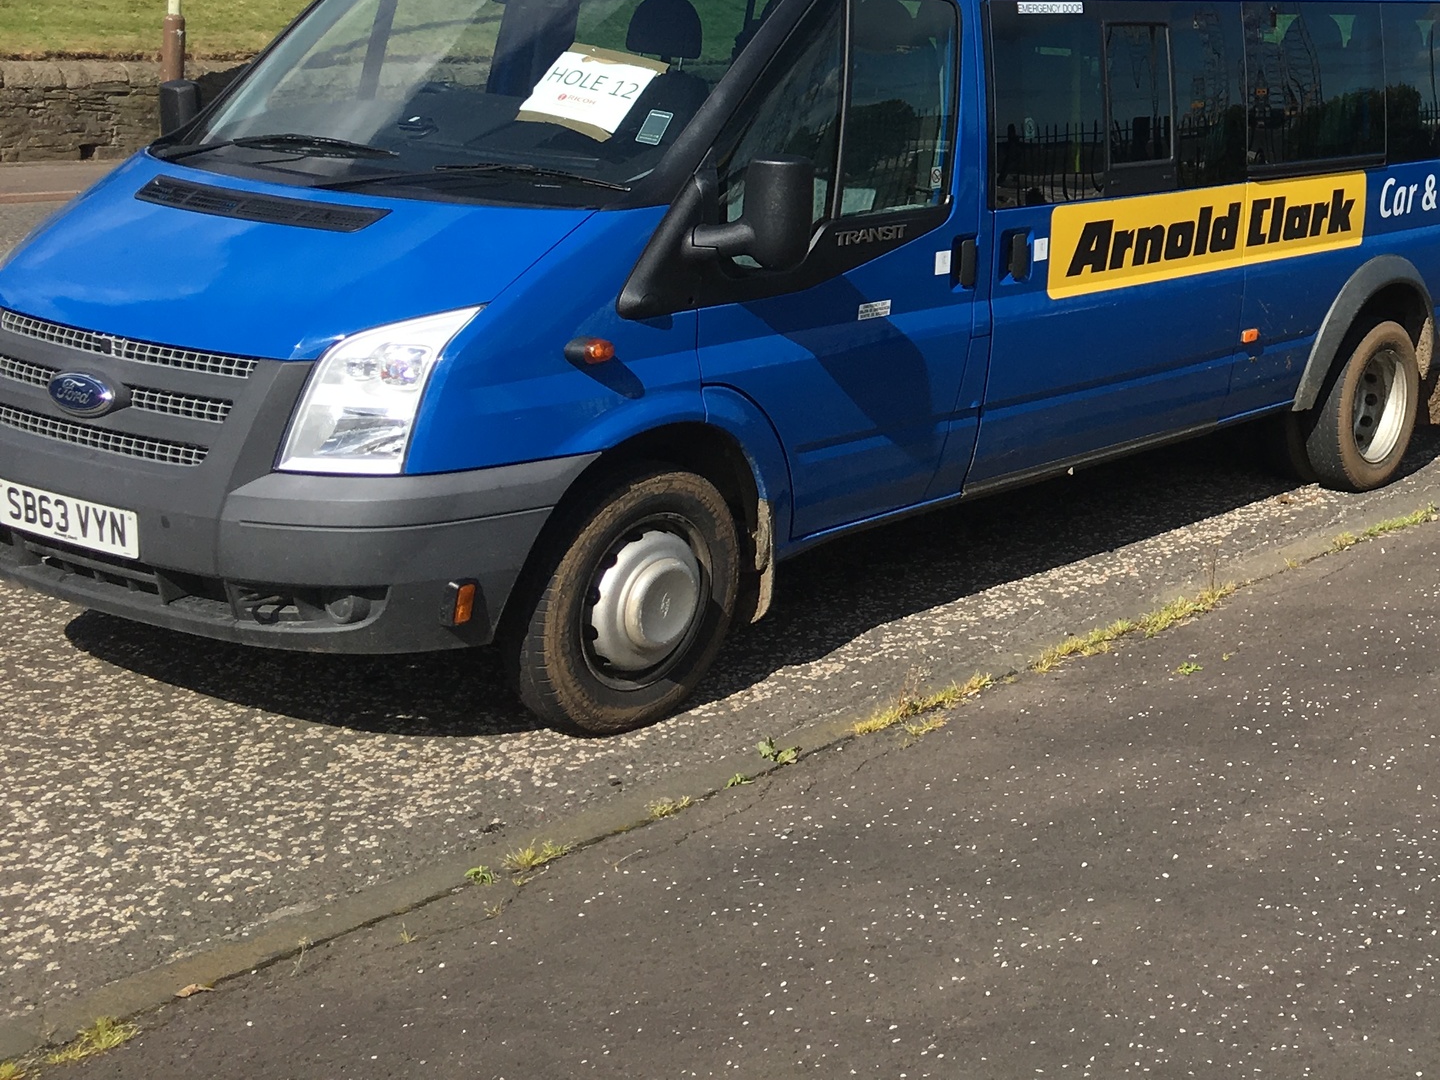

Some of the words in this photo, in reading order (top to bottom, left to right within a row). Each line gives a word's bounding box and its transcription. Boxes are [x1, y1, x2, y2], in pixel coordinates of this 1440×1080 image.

[1017, 3, 1061, 13] EMERGENCY
[1062, 3, 1082, 13] DOOR
[547, 67, 609, 91] HOLE
[608, 80, 639, 100] 12
[567, 94, 597, 105] RICOH
[1379, 177, 1418, 218] Car
[1421, 173, 1438, 211] &
[834, 224, 908, 247] TRANSIT
[1065, 201, 1242, 278] Arnold
[1246, 188, 1356, 248] Clark
[56, 378, 93, 405] Ford
[7, 486, 69, 533] SB63
[75, 503, 126, 548] VYN
